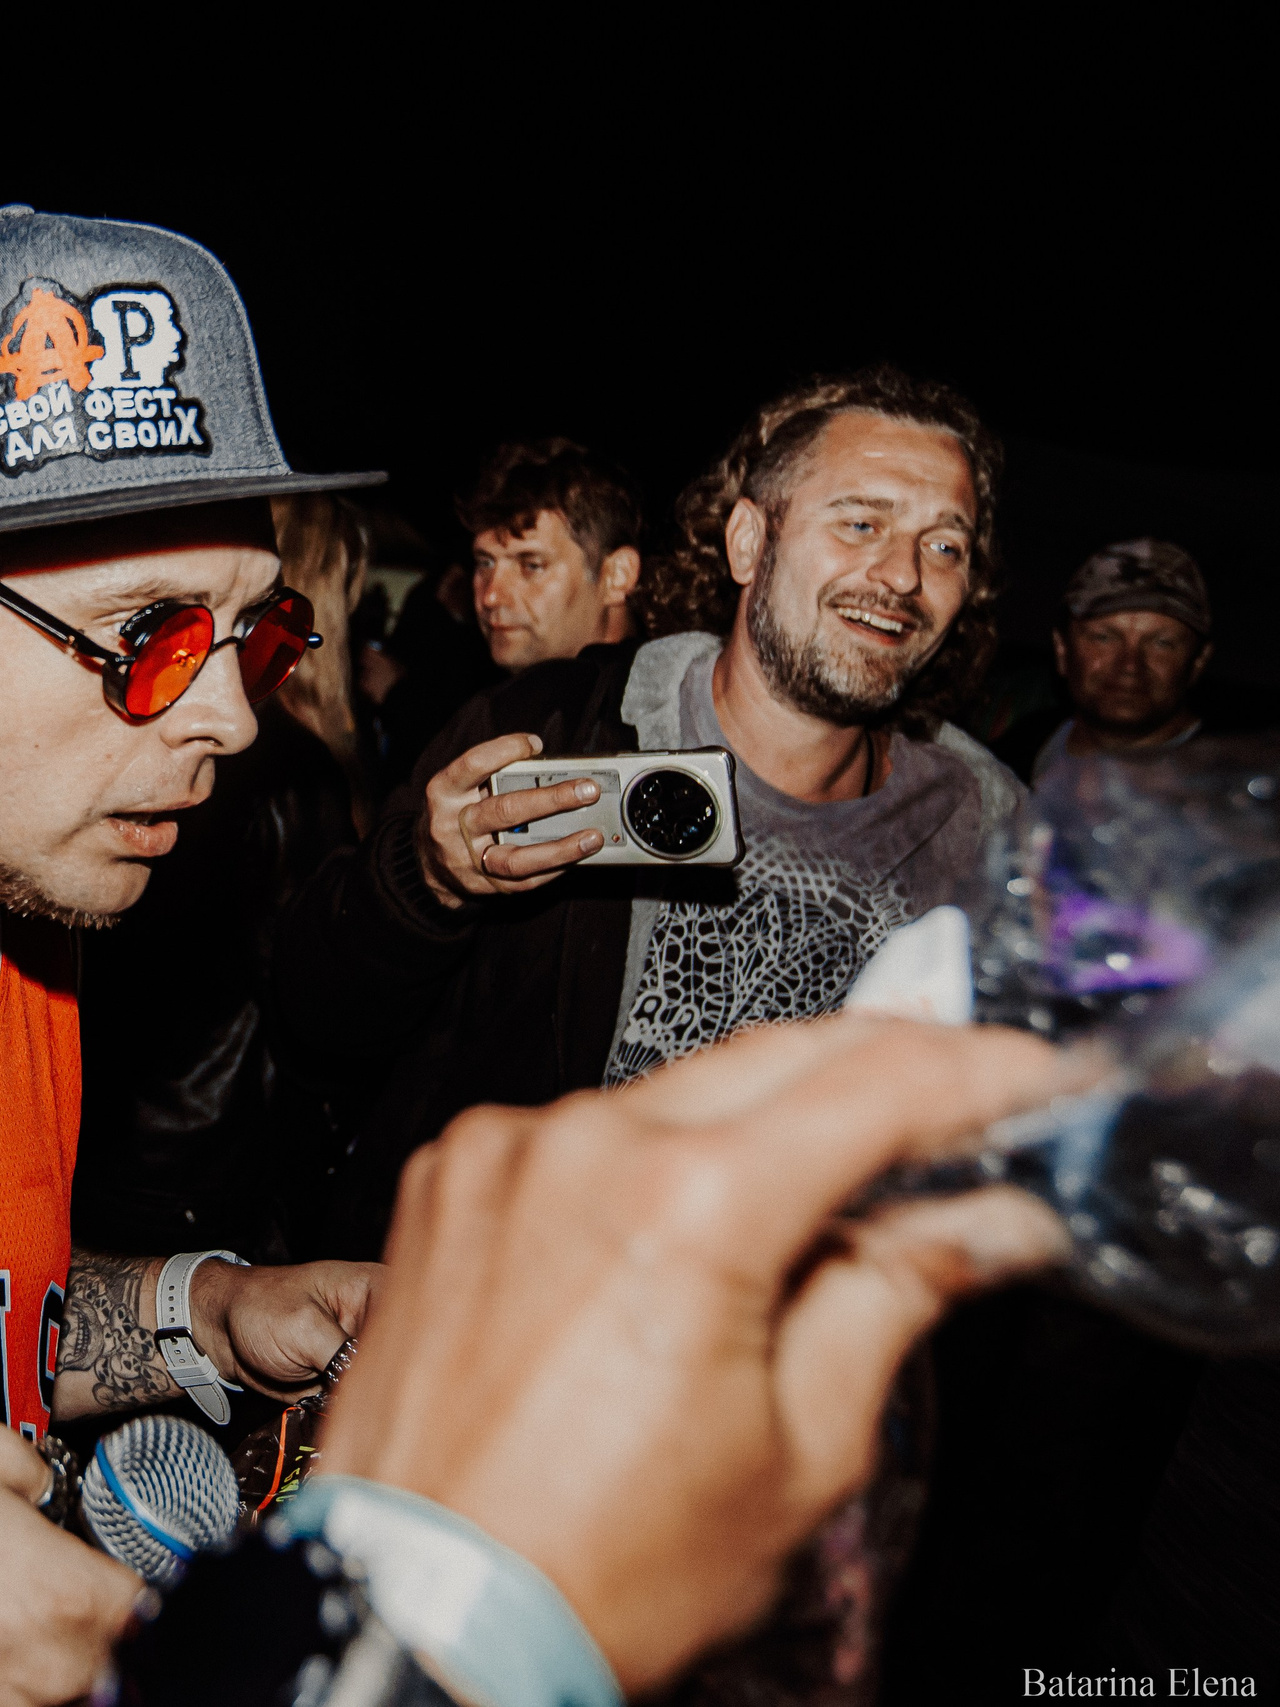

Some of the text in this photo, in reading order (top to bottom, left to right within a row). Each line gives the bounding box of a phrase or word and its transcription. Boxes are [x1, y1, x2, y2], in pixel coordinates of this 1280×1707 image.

[85, 389, 176, 420] ФЕСТ
[5, 407, 203, 467] ДЛЯ СВОИХ
